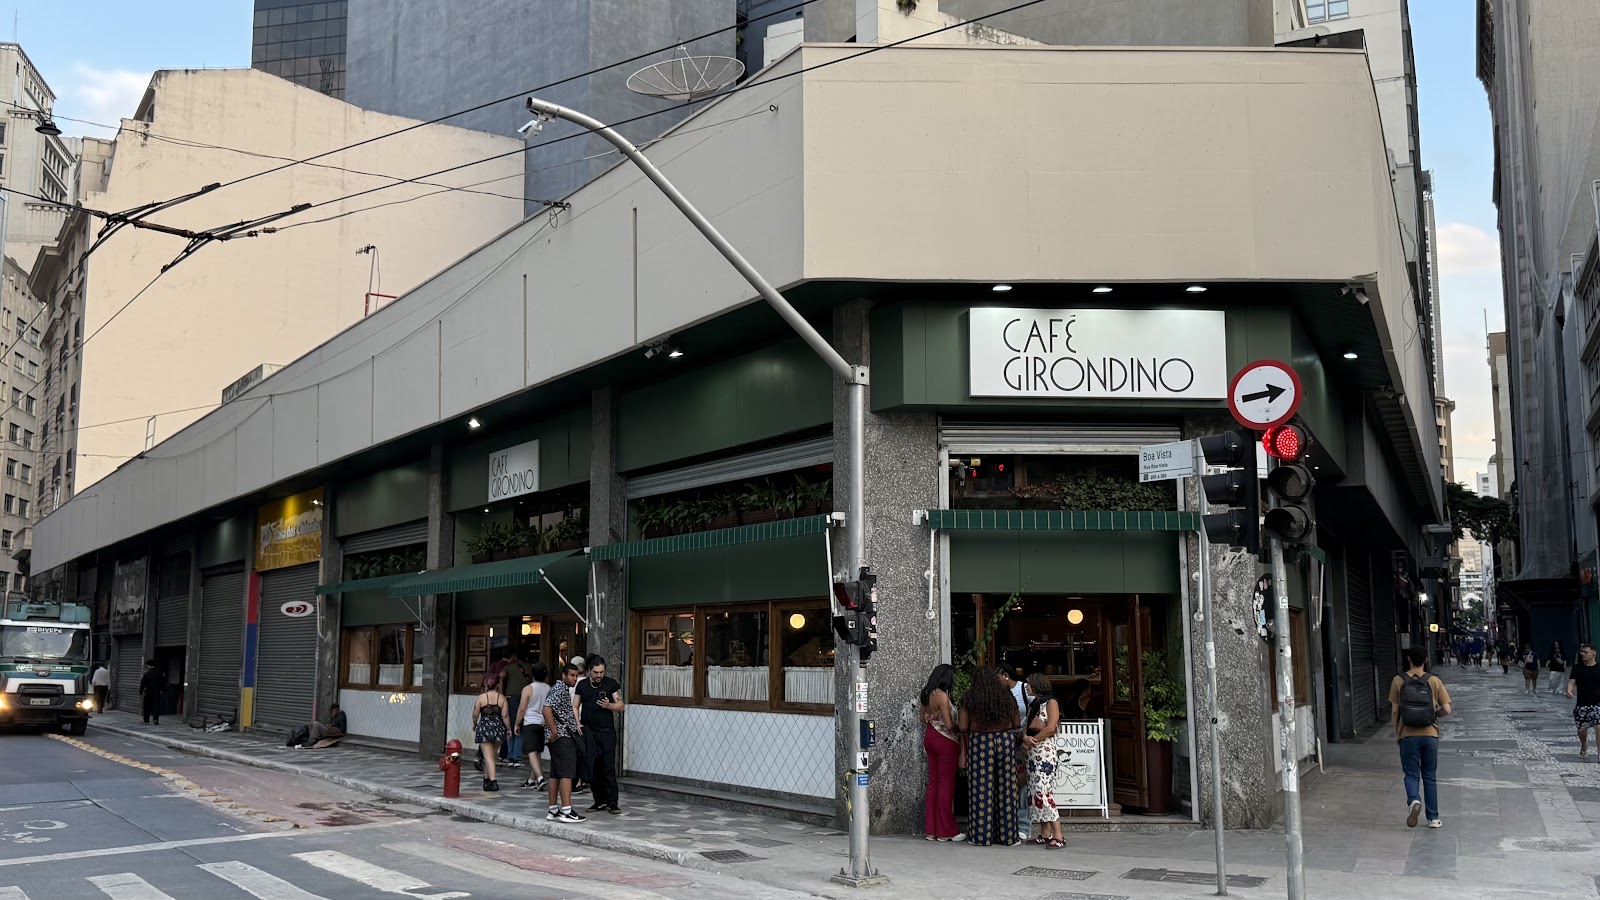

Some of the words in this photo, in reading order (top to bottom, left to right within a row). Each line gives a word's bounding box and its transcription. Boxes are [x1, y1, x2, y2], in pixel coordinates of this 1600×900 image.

[1003, 314, 1077, 354] CAFÉ
[1003, 356, 1194, 393] GIRONDINO
[491, 451, 508, 477] CAFÉ
[1143, 452, 1155, 462] Boa
[1156, 450, 1172, 460] Vista
[491, 469, 534, 498] GIRONDINO
[1056, 737, 1096, 748] ONDINO
